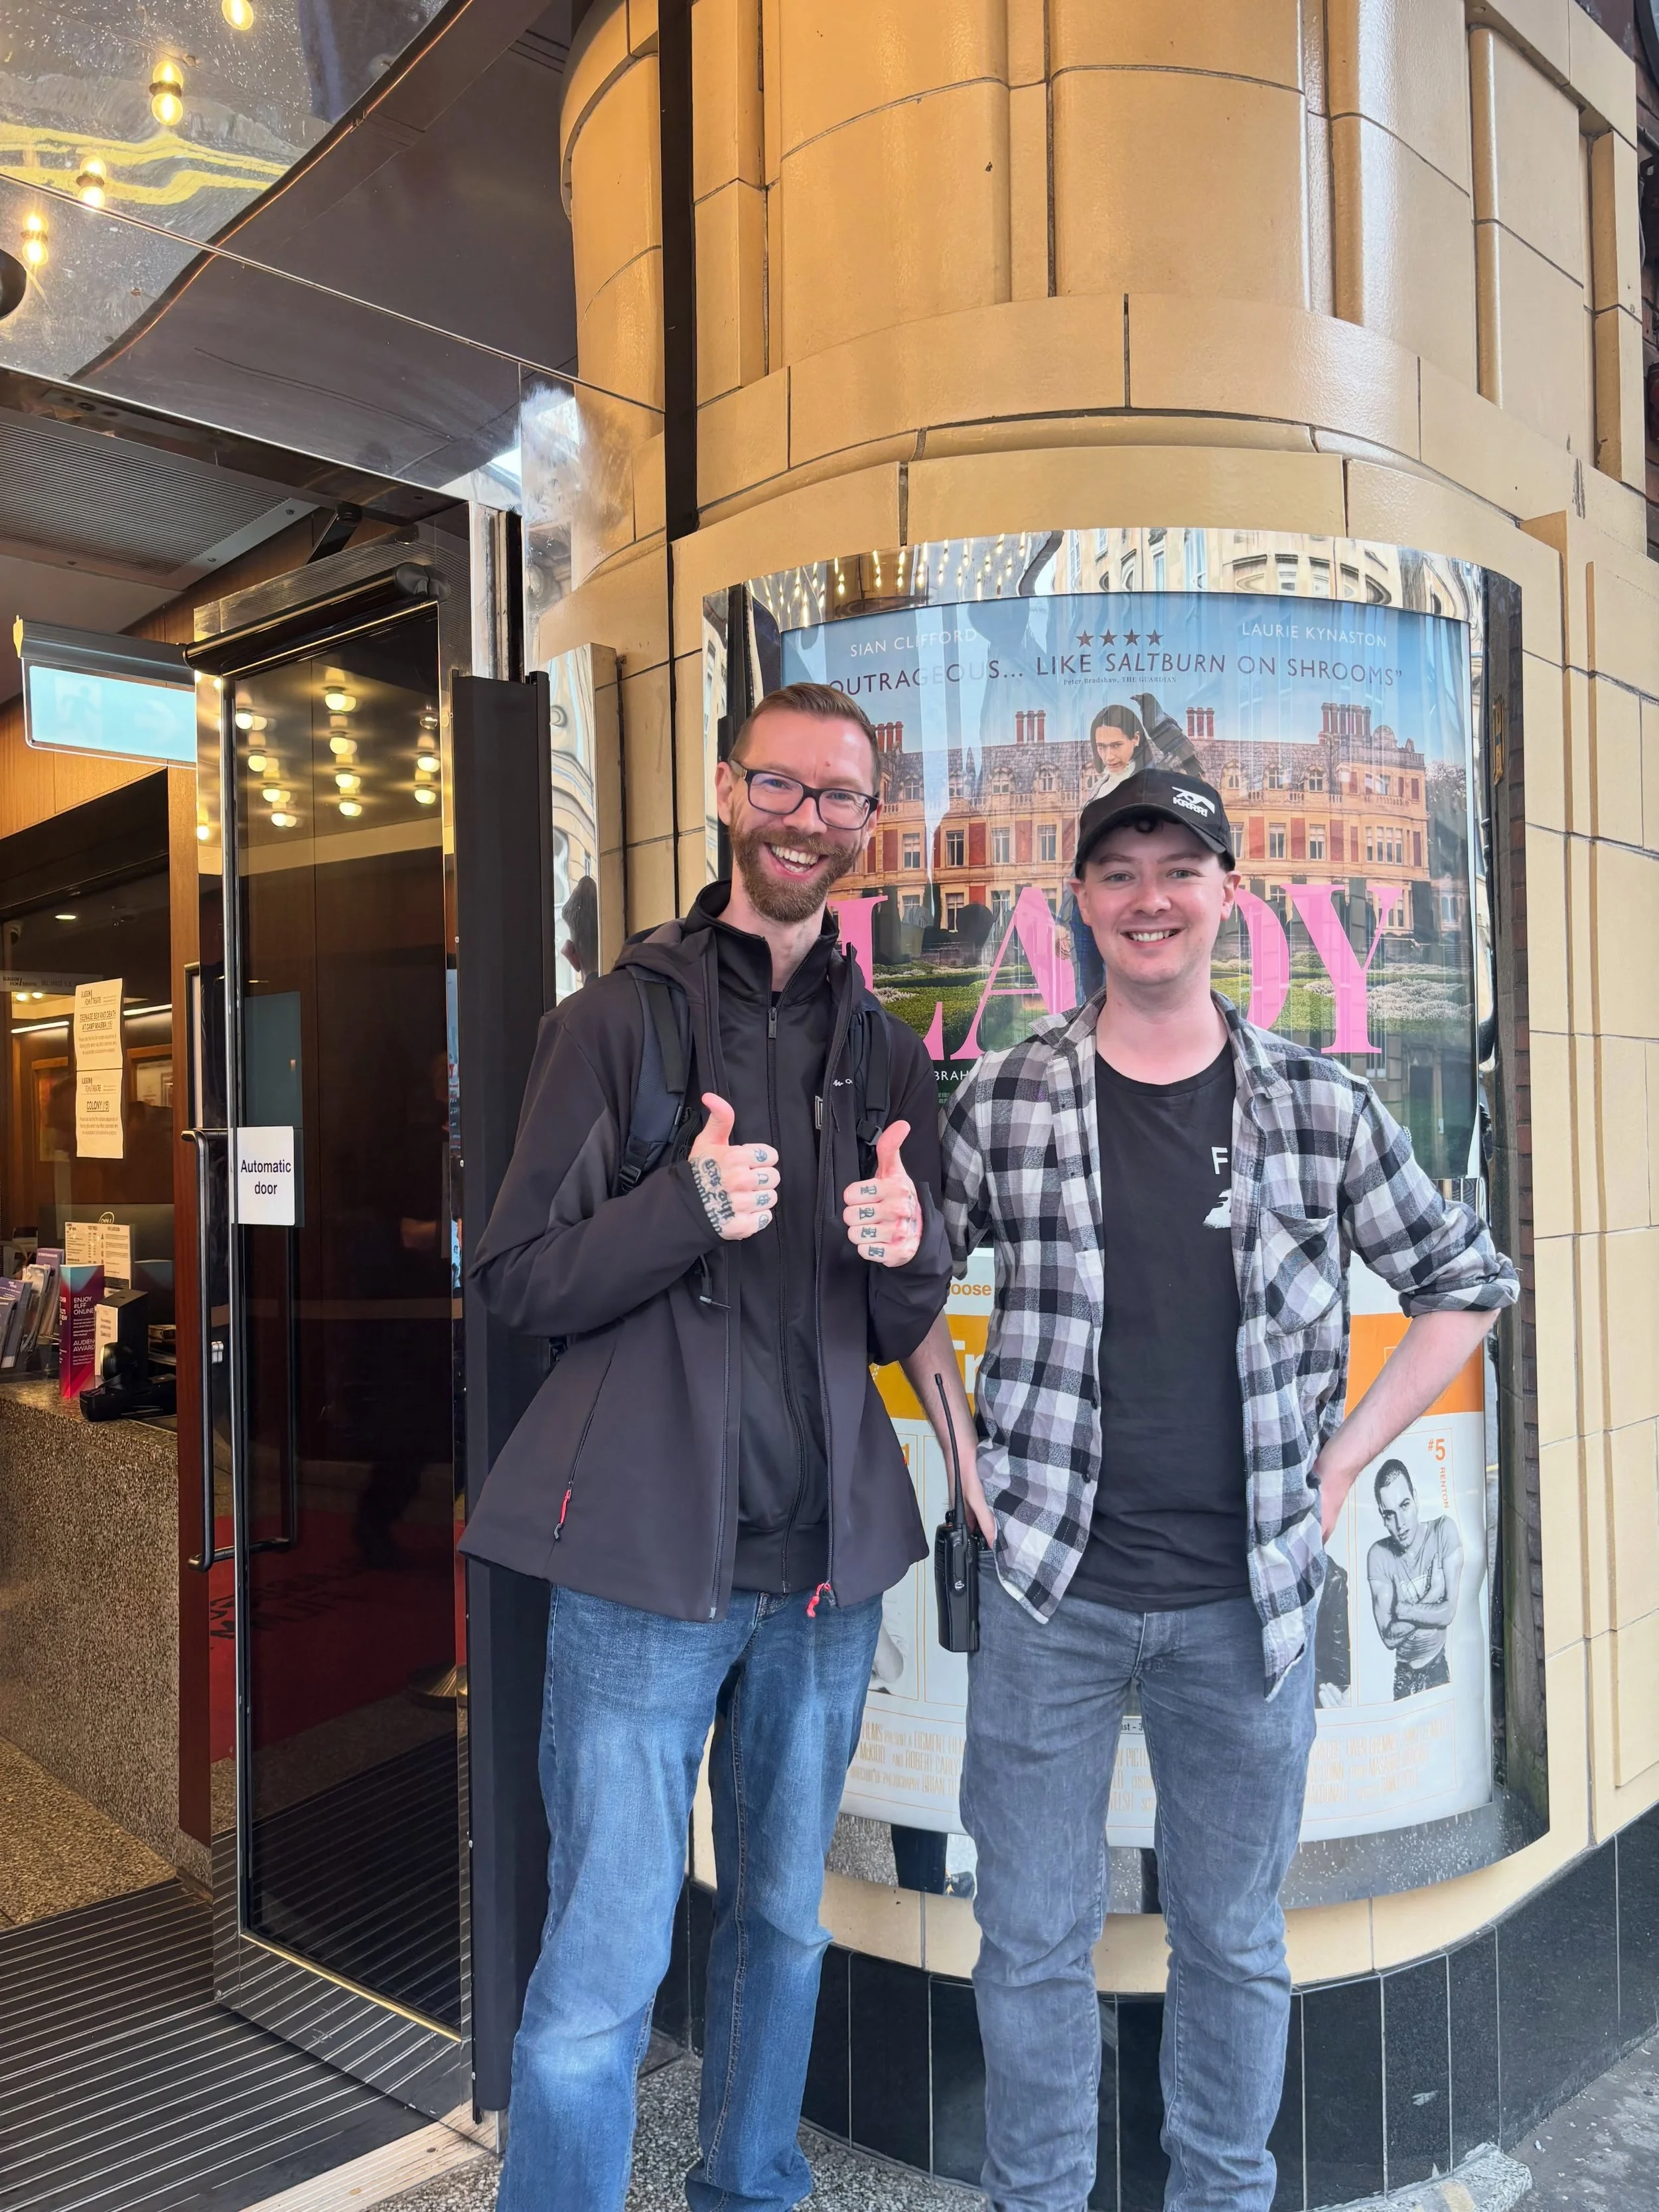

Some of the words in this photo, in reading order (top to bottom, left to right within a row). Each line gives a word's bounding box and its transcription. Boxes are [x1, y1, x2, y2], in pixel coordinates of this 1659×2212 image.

[1242, 622, 1299, 639] LAURIE
[1306, 627, 1386, 648] KYNASTON
[849, 640, 887, 658] SIAN
[894, 628, 977, 650] CLIFFORD
[1037, 654, 1092, 676] LIKE
[1105, 652, 1226, 673] SALTBURN
[1237, 655, 1275, 676] ON
[80, 1012, 93, 1021] TEENAGE
[107, 1009, 117, 1018] DEATH
[934, 1069, 970, 1081] BRAH
[86, 1101, 102, 1110] COLONY
[240, 1159, 291, 1173] Automatic
[254, 1181, 278, 1195] door
[950, 1283, 992, 1296] oose
[1427, 1438, 1446, 1461] #5
[1439, 1466, 1449, 1509] RENTON
